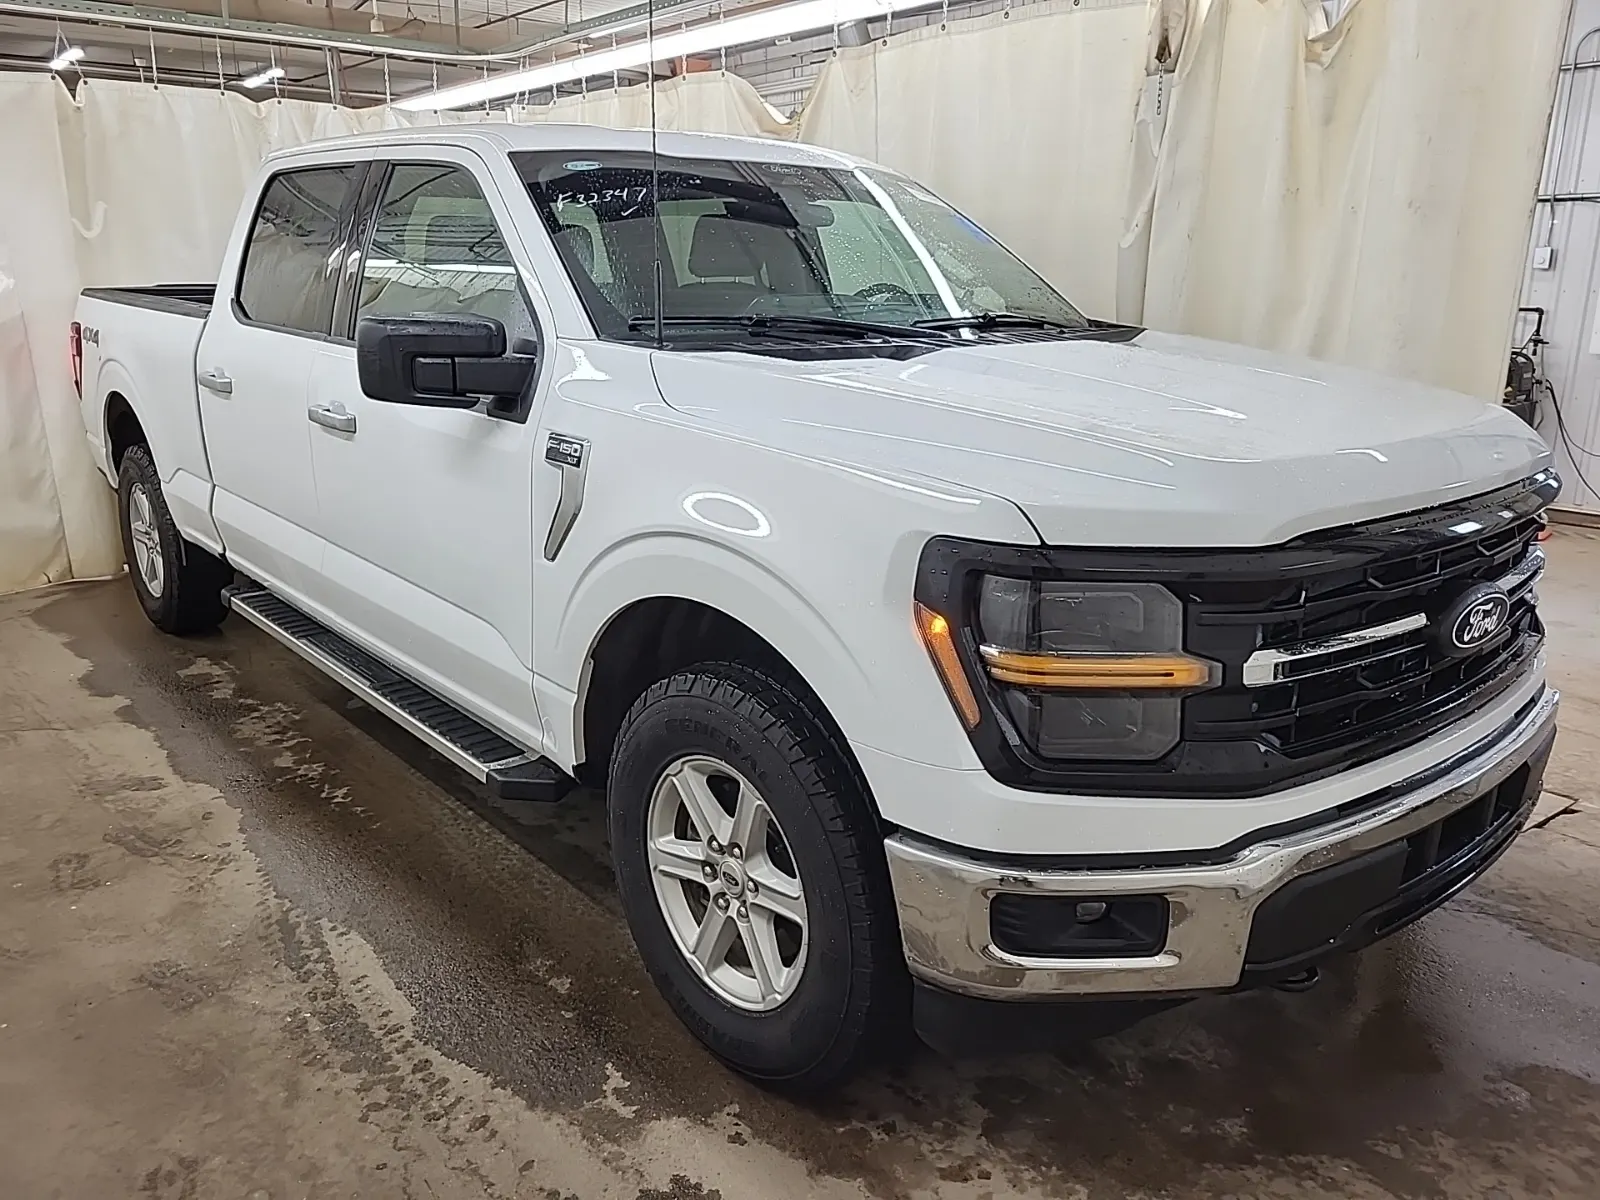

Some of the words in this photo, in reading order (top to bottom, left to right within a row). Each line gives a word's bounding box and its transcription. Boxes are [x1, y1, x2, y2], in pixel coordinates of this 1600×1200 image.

[557, 187, 647, 213] F32347
[548, 440, 581, 456] F-150
[1463, 601, 1502, 643] Ford
